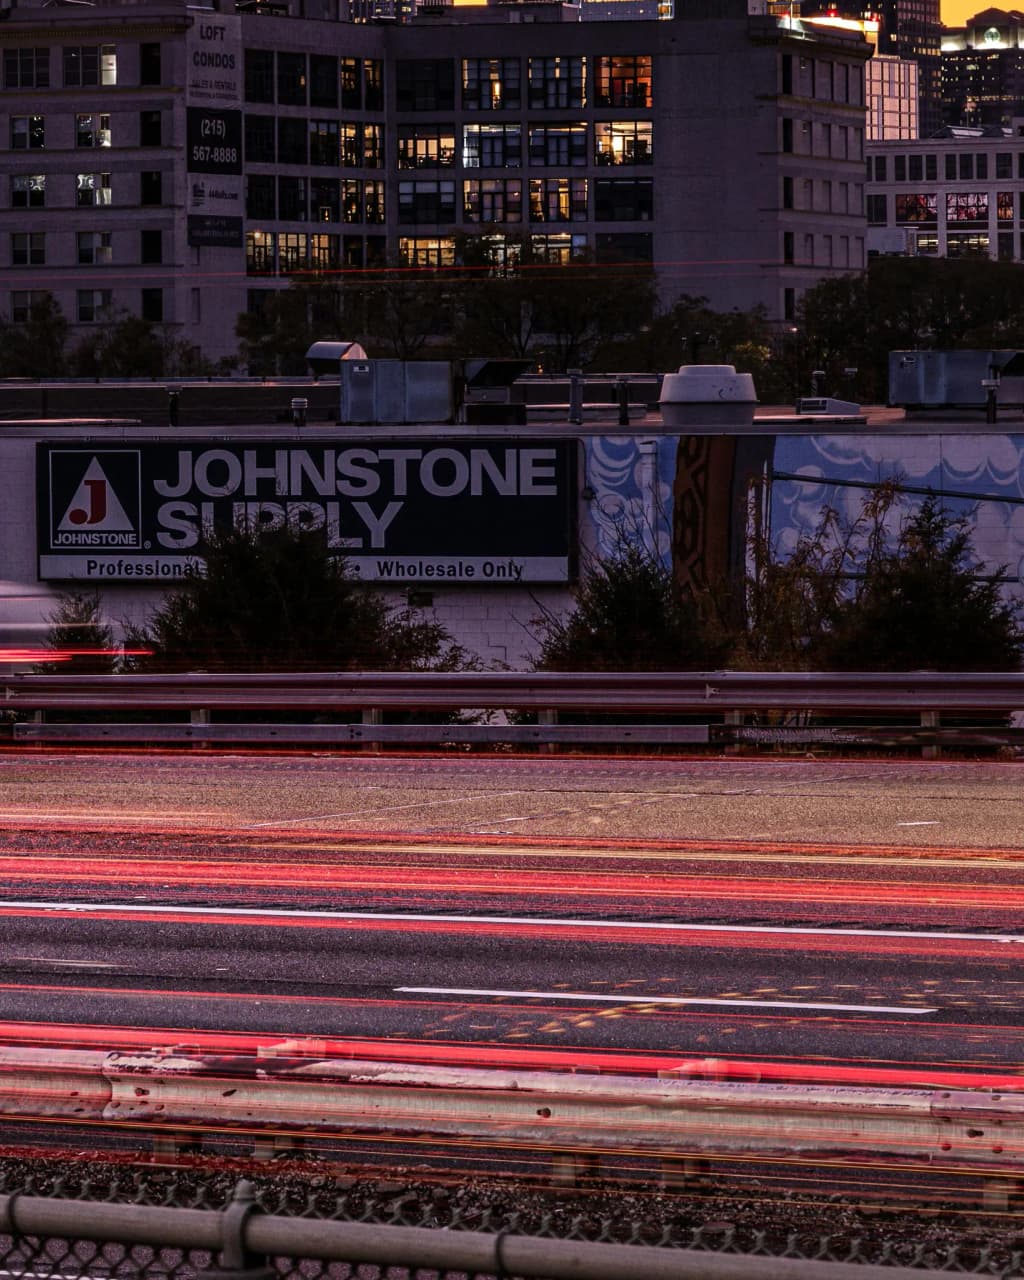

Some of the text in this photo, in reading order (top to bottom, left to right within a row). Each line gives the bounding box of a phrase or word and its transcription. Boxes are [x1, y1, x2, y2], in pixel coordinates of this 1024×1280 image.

[200, 25, 226, 40] LOFT
[193, 51, 236, 69] CONDOS
[200, 119, 226, 138] (215)
[193, 147, 237, 163] 567-8888
[153, 448, 557, 497] JOHNSTONE
[156, 500, 405, 549] SUPPLY
[54, 533, 138, 545] JOHNSTONE
[86, 559, 200, 576] Professional
[376, 560, 524, 580] Wholesale Only
